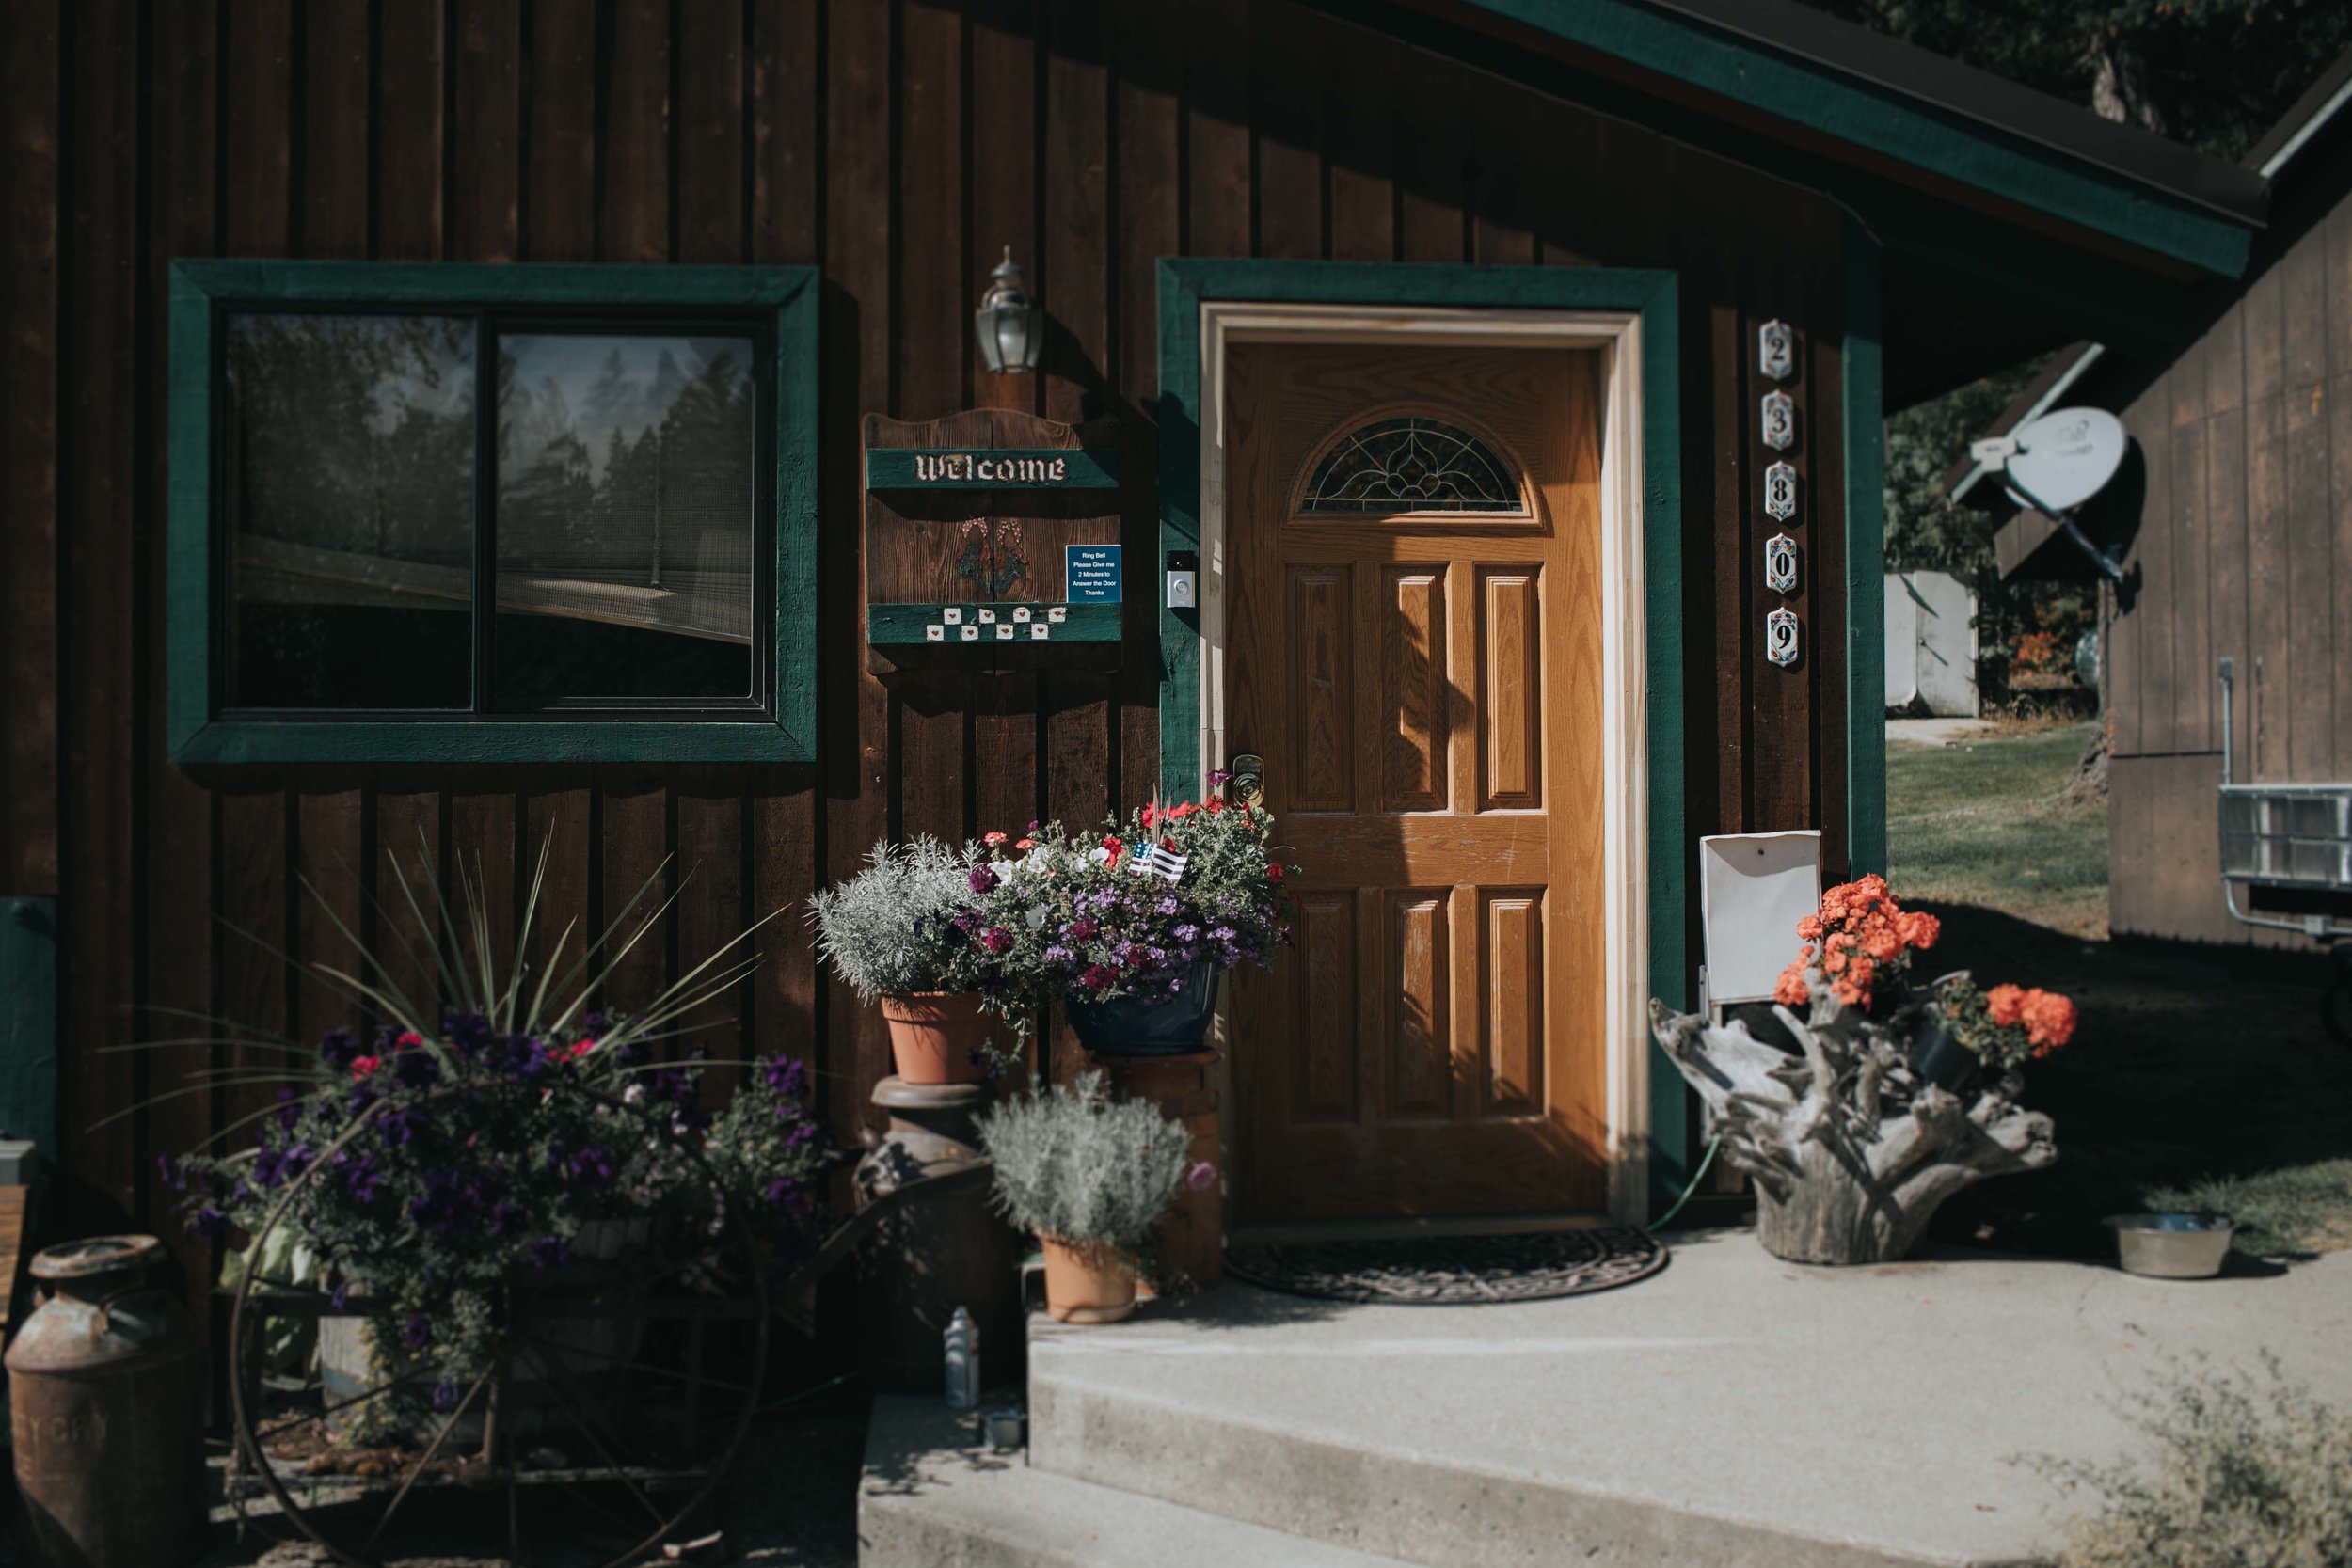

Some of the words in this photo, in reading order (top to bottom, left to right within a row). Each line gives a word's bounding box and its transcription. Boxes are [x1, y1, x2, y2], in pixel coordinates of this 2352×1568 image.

[1771, 339, 1785, 361] 2
[1772, 408, 1786, 434] 3
[915, 454, 1066, 482] Welcome
[1773, 479, 1788, 502] 8
[1775, 552, 1790, 577] 0
[1777, 625, 1792, 650] 9
